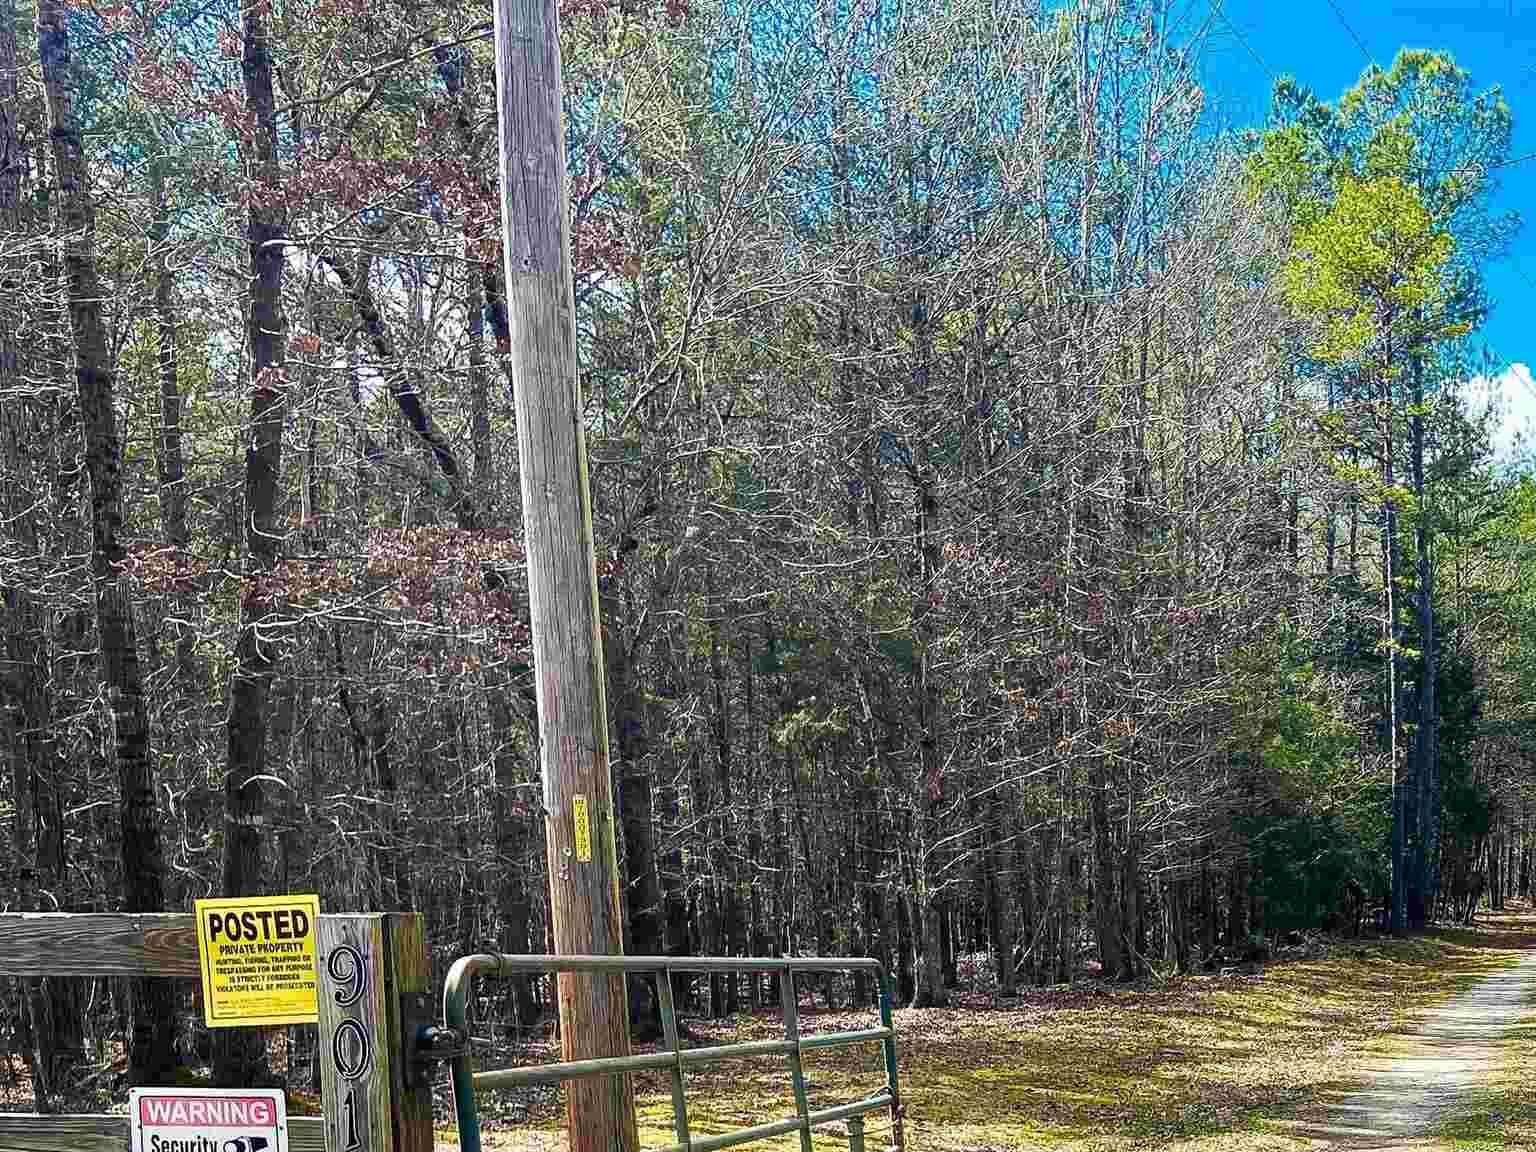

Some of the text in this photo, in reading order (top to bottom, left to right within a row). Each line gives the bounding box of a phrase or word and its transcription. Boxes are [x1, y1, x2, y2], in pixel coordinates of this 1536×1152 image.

[208, 909, 309, 942] POSTED
[219, 943, 304, 955] PRIVATE PROPERTY
[327, 943, 370, 1152] 901
[147, 1100, 270, 1124] WARNING
